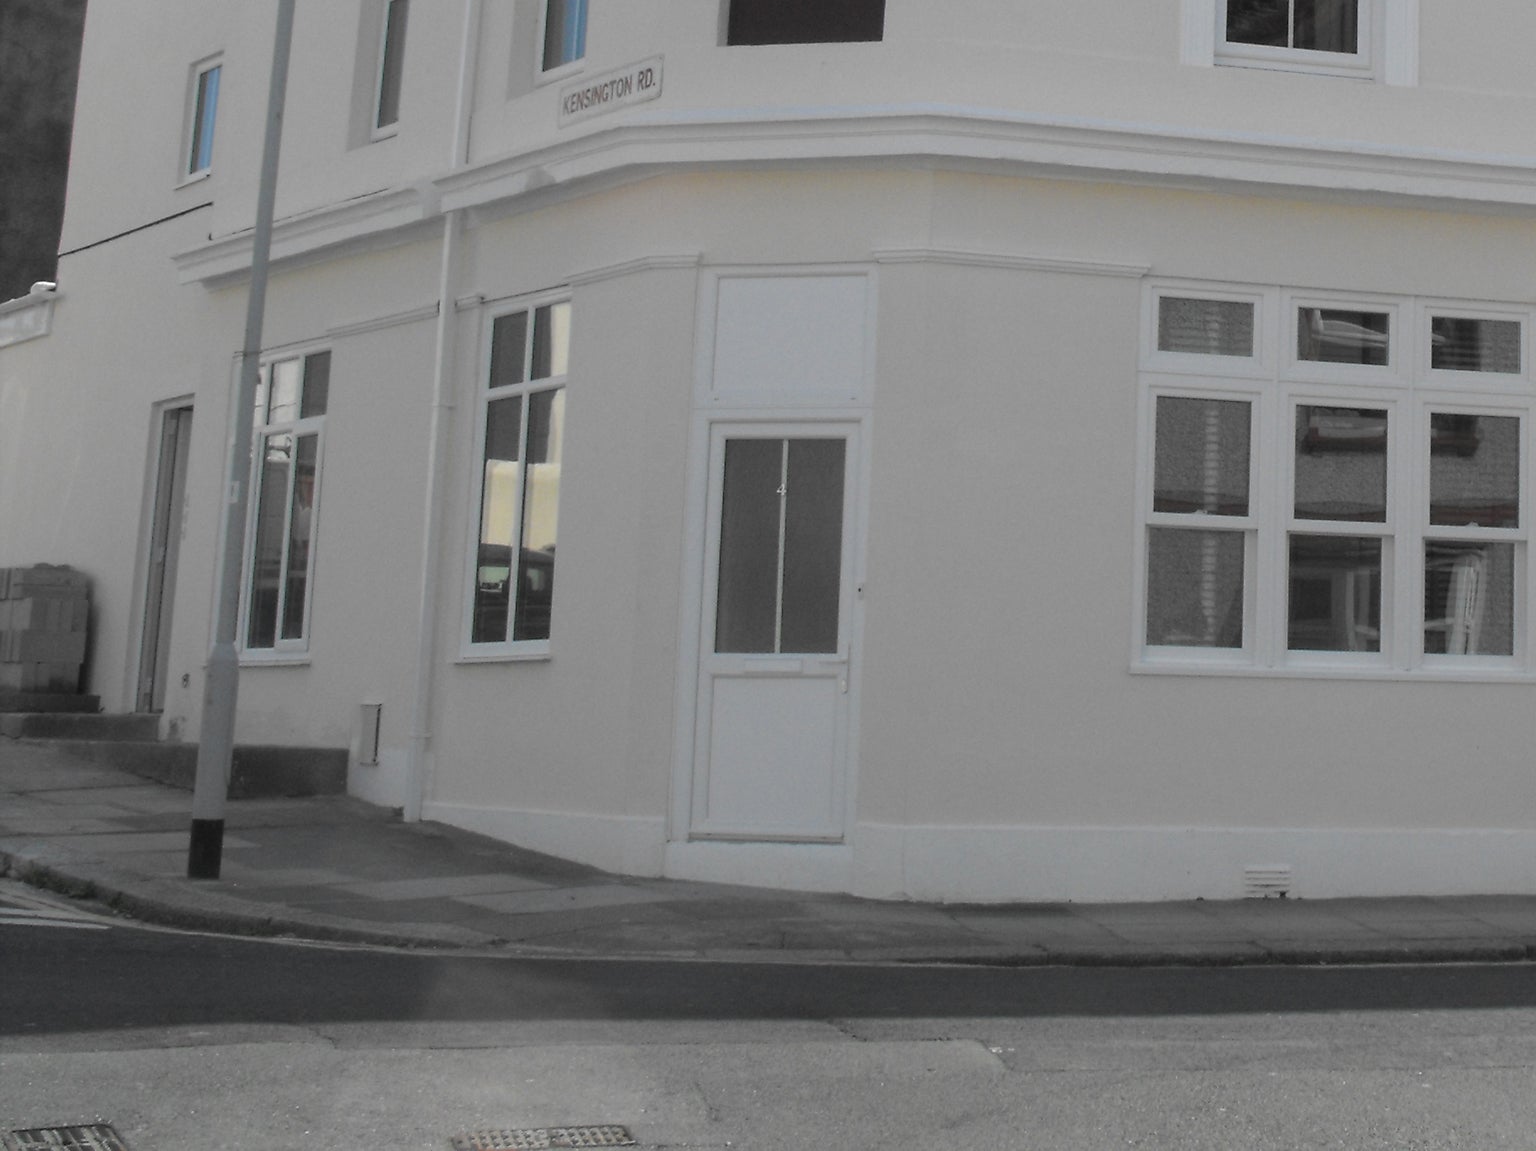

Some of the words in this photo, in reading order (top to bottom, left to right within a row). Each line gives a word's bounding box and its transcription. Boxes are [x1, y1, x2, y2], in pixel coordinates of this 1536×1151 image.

[562, 74, 633, 116] KENSINGTON
[637, 67, 656, 92] RD.
[776, 483, 787, 496] 4
